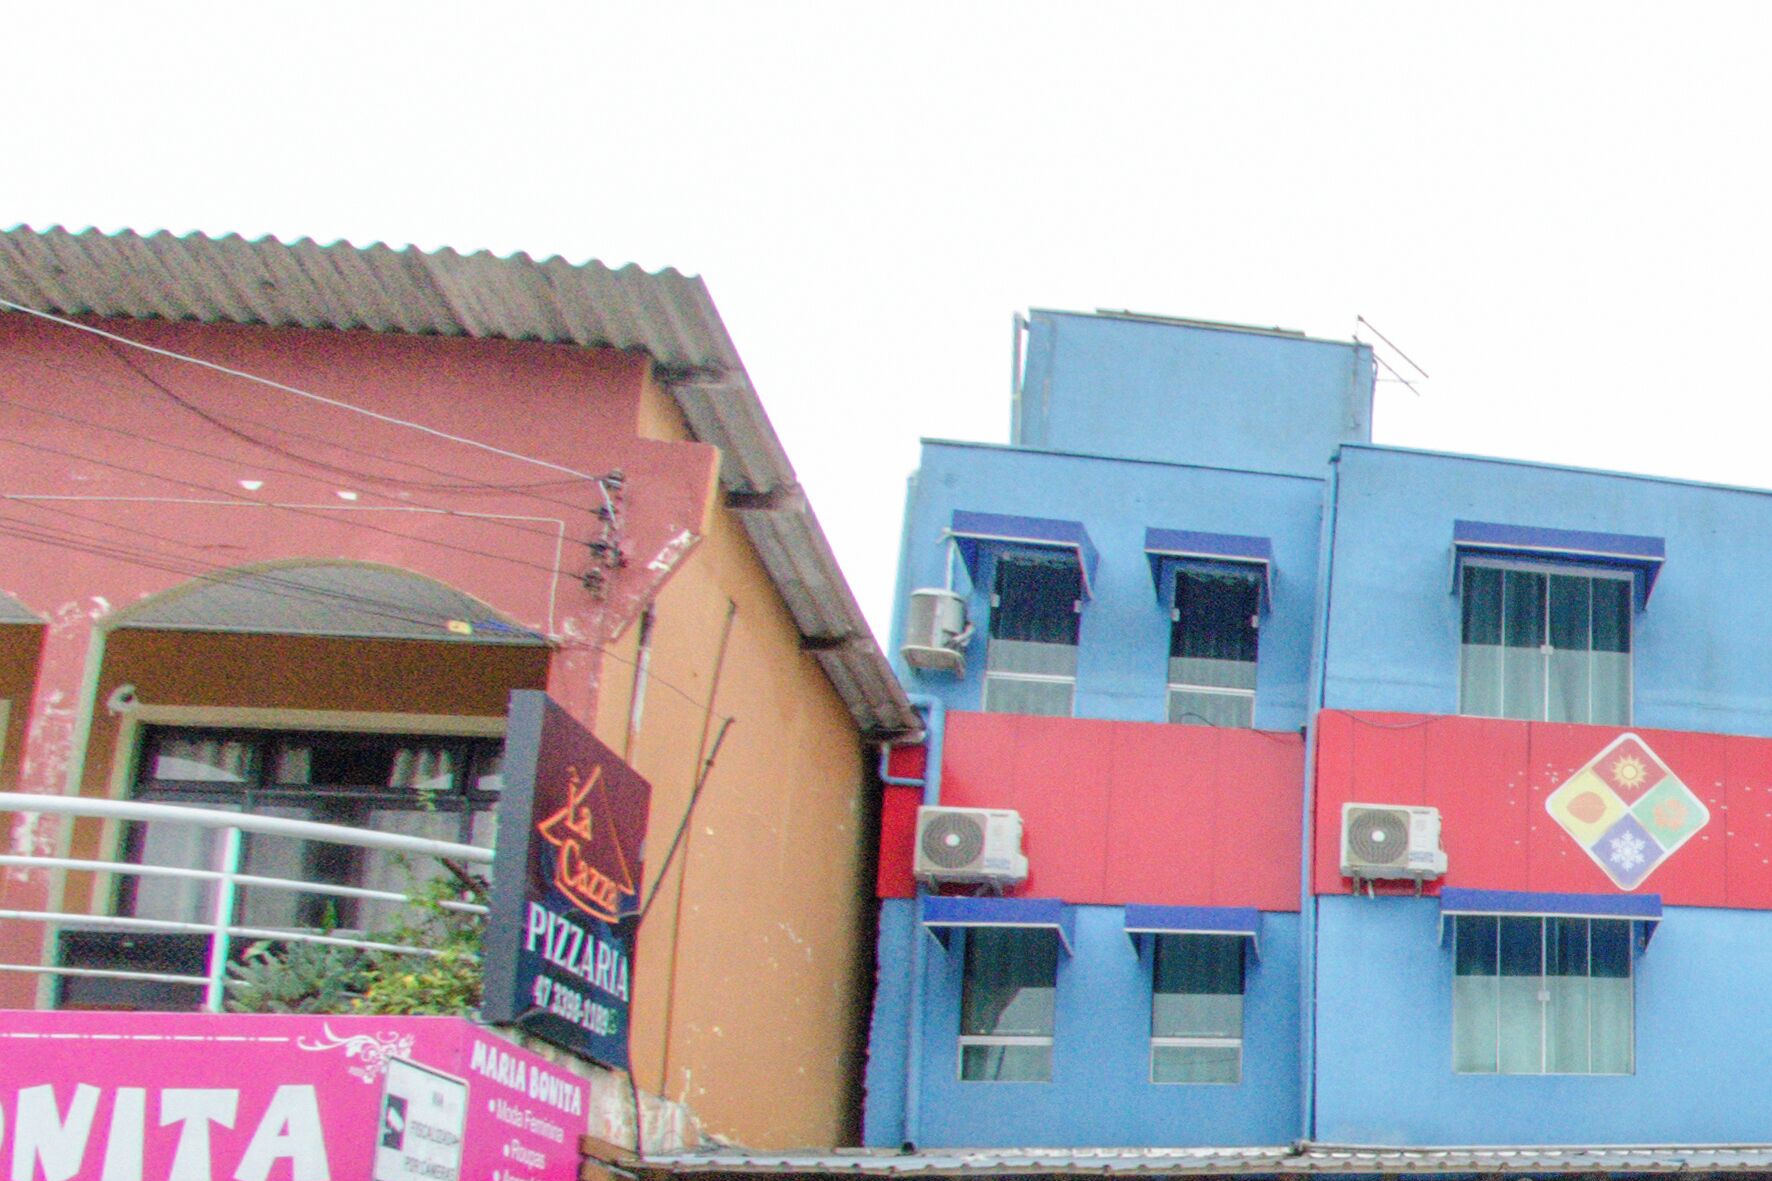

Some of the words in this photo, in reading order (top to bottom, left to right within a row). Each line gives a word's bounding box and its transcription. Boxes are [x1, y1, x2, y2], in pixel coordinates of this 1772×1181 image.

[525, 901, 629, 1003] PIZZARIA
[471, 1040, 526, 1092] MARIA
[529, 1066, 582, 1116] BONITA
[496, 1099, 523, 1127] Moda
[524, 1109, 564, 1144] Feminina
[511, 1139, 545, 1170] Roupas
